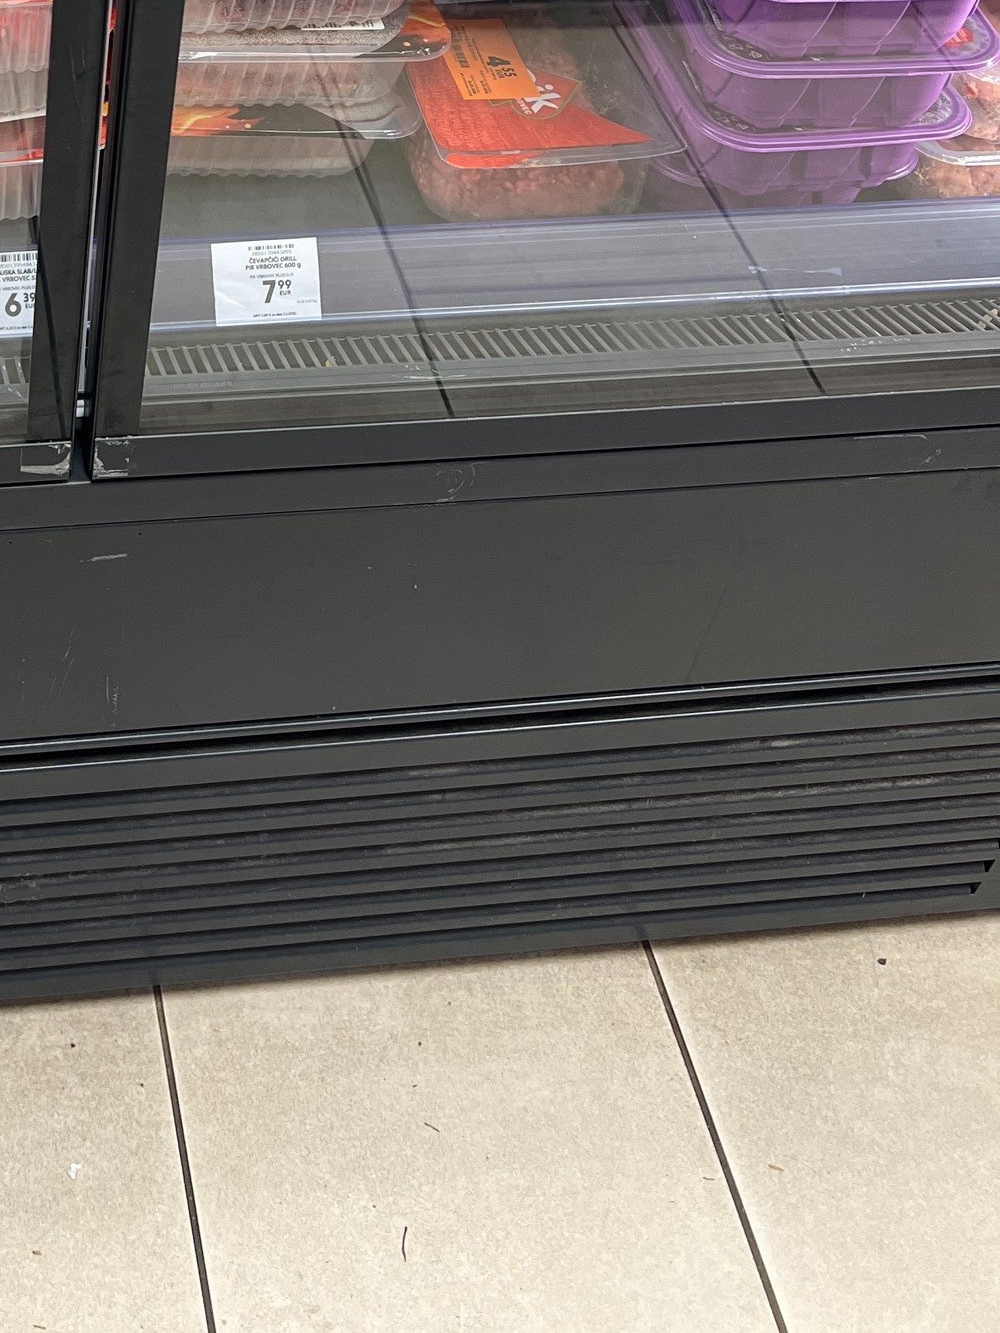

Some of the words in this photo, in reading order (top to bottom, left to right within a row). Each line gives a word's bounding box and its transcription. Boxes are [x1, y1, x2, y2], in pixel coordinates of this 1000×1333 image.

[262, 280, 276, 303] 7
[278, 280, 291, 289] 99
[5, 293, 22, 317] 6
[23, 293, 35, 302] 39
